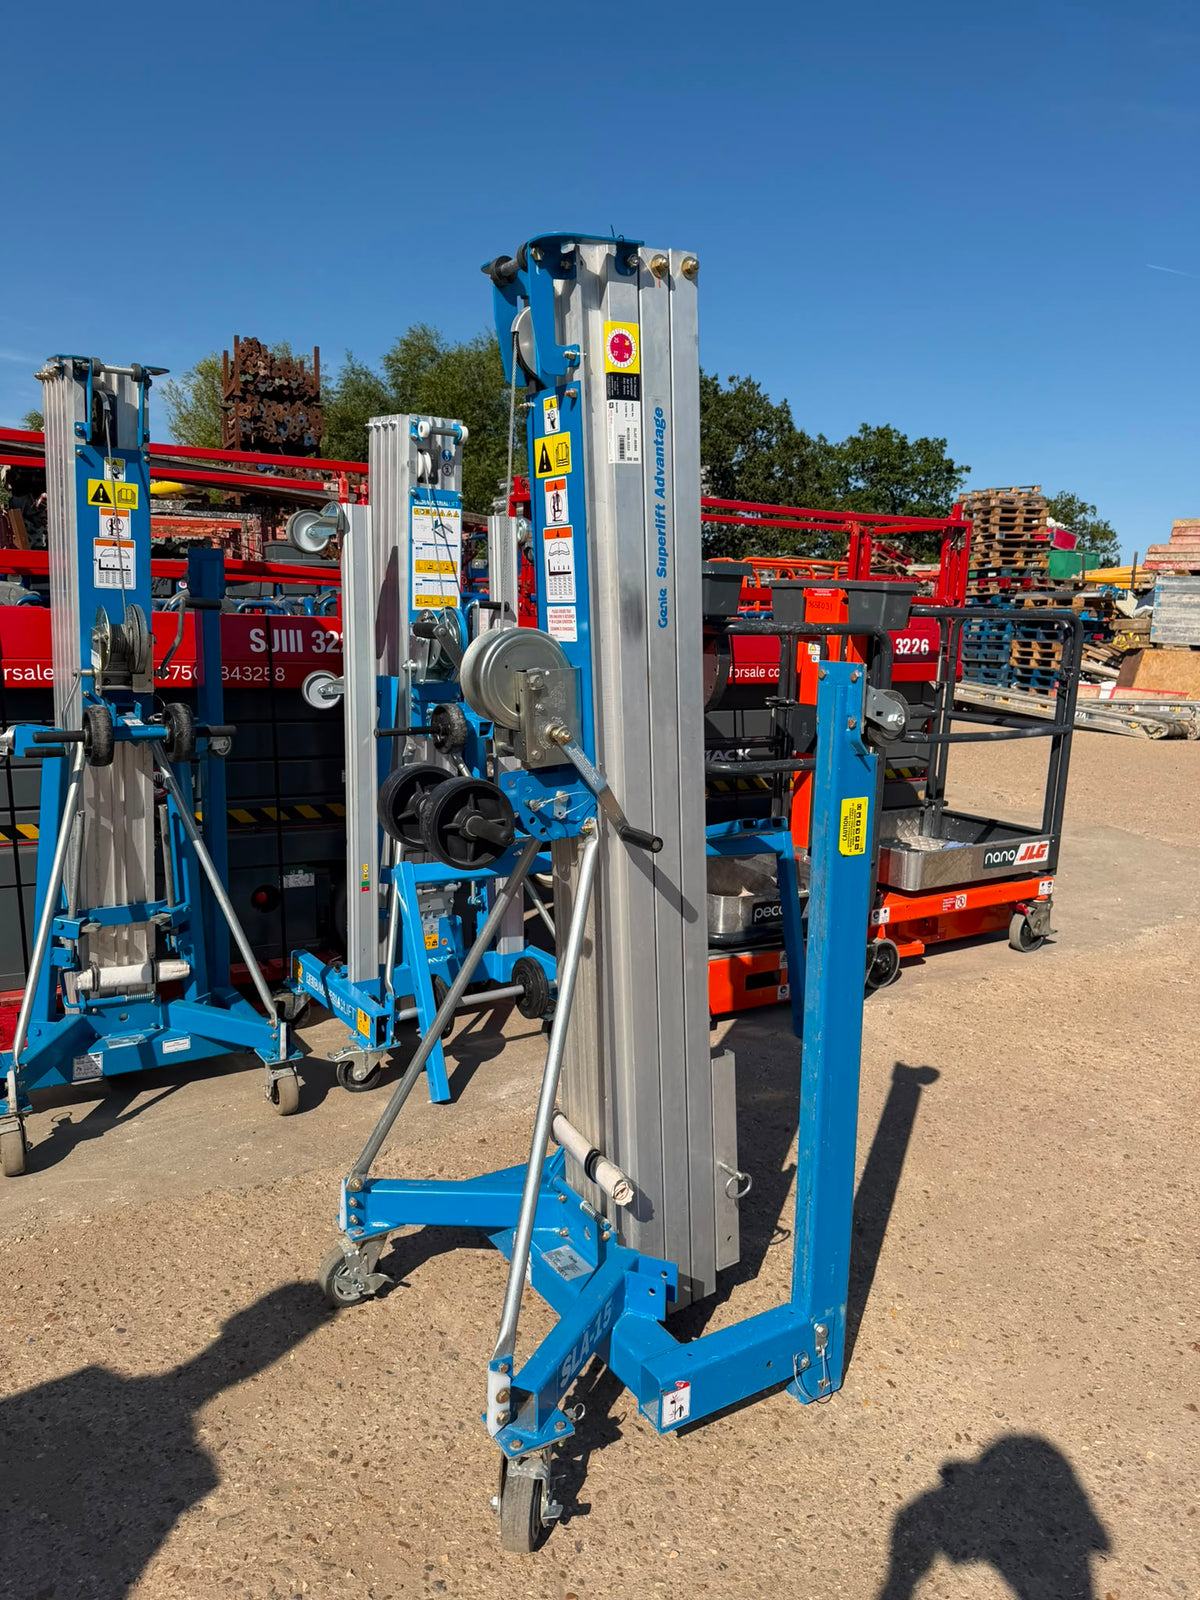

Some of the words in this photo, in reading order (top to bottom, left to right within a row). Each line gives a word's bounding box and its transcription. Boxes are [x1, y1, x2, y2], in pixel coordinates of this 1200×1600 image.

[654, 406, 666, 499] Advantage
[655, 504, 669, 578] Superlift
[658, 588, 668, 628] Genie
[311, 630, 344, 653] 32
[895, 638, 929, 655] 3226
[729, 665, 766, 678] forsale
[985, 849, 1016, 865] nano
[1019, 843, 1048, 862] JLG
[560, 1298, 612, 1388] SLA-15
